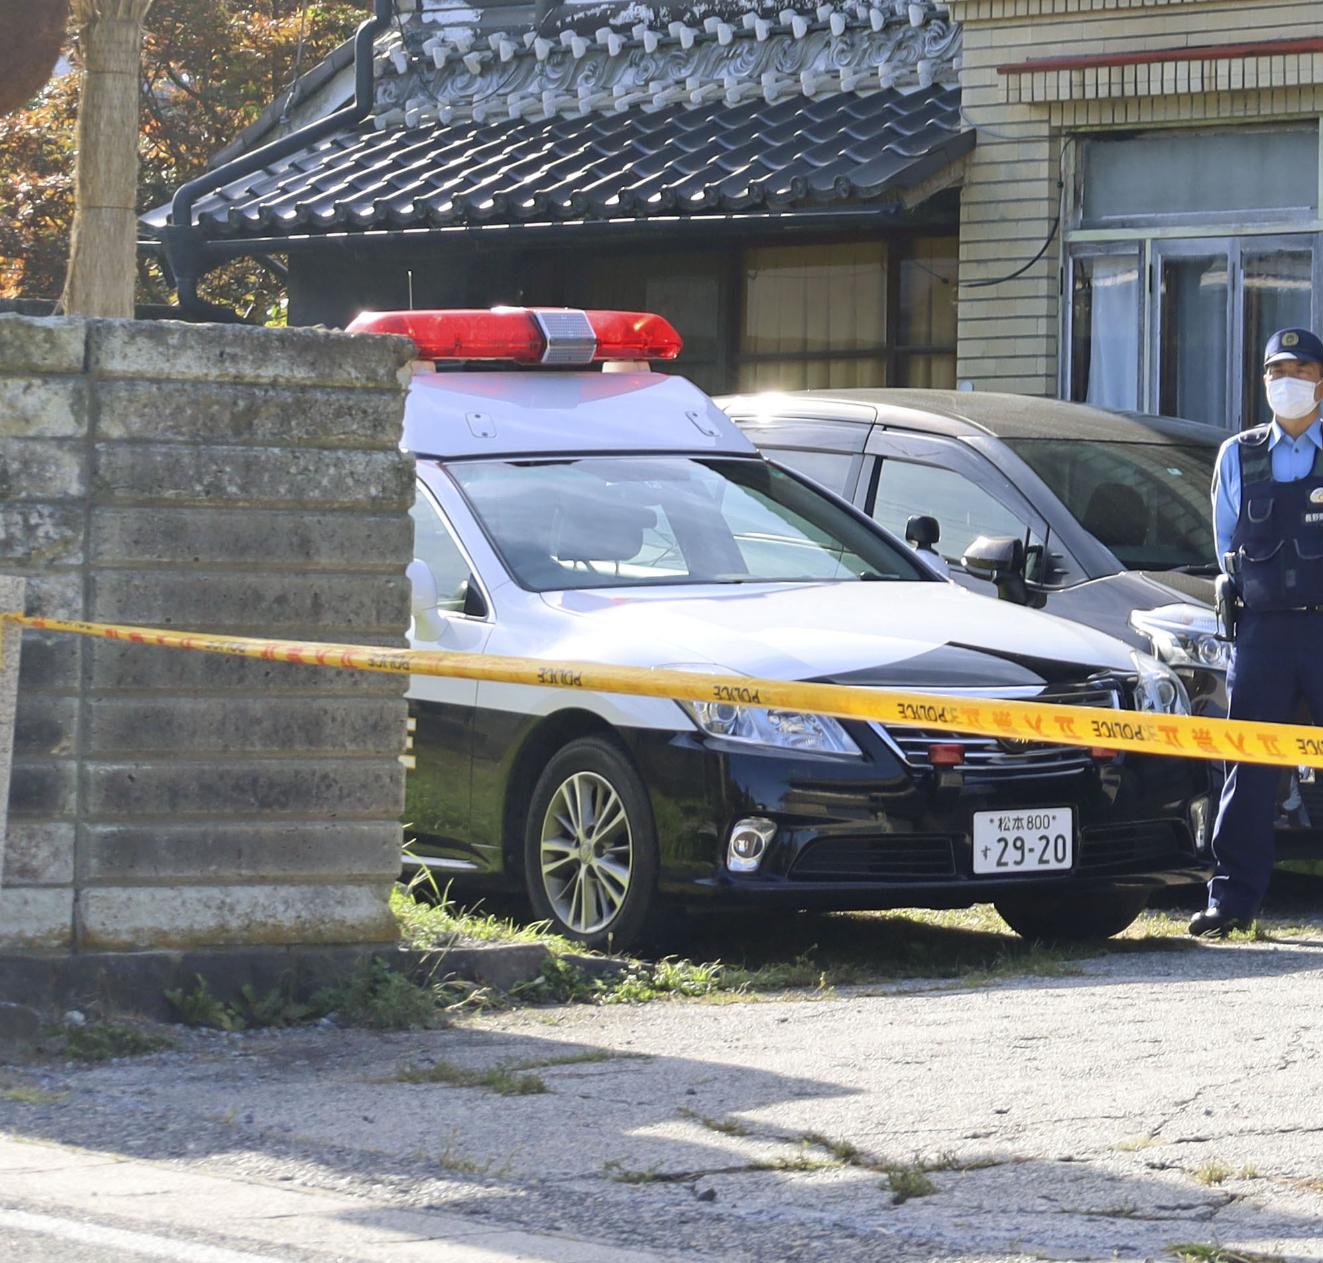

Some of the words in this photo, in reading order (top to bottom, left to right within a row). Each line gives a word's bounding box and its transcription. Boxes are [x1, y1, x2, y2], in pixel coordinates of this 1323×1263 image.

[539, 667, 583, 687] POLICE
[713, 685, 761, 705] POLICE
[897, 703, 949, 724] POLICE
[1092, 720, 1145, 742] POLICE
[996, 834, 1067, 867] 29-20
